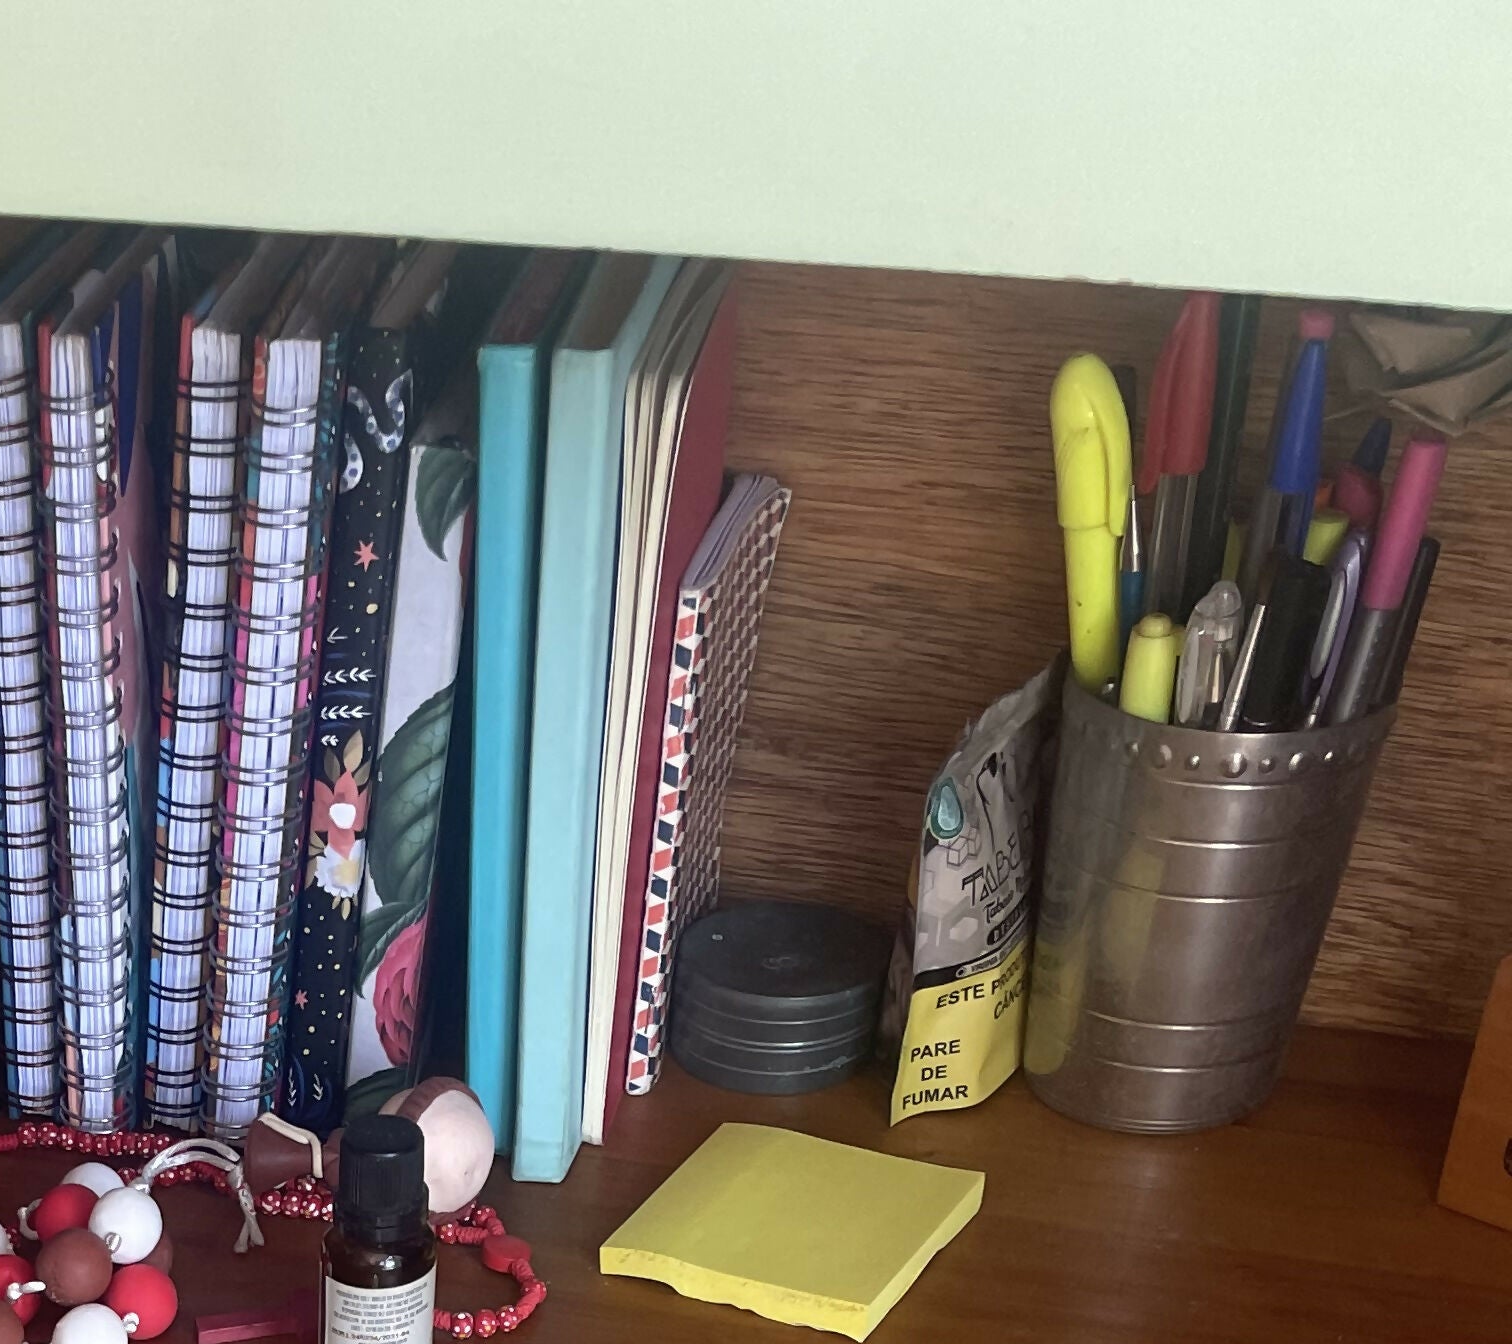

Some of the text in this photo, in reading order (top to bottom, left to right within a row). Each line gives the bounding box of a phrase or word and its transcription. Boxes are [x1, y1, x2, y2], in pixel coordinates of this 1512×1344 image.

[935, 983, 986, 1010] ESTE
[910, 1039, 962, 1063] PARE
[921, 1065, 948, 1082] DE
[902, 1084, 969, 1111] FUMAR
